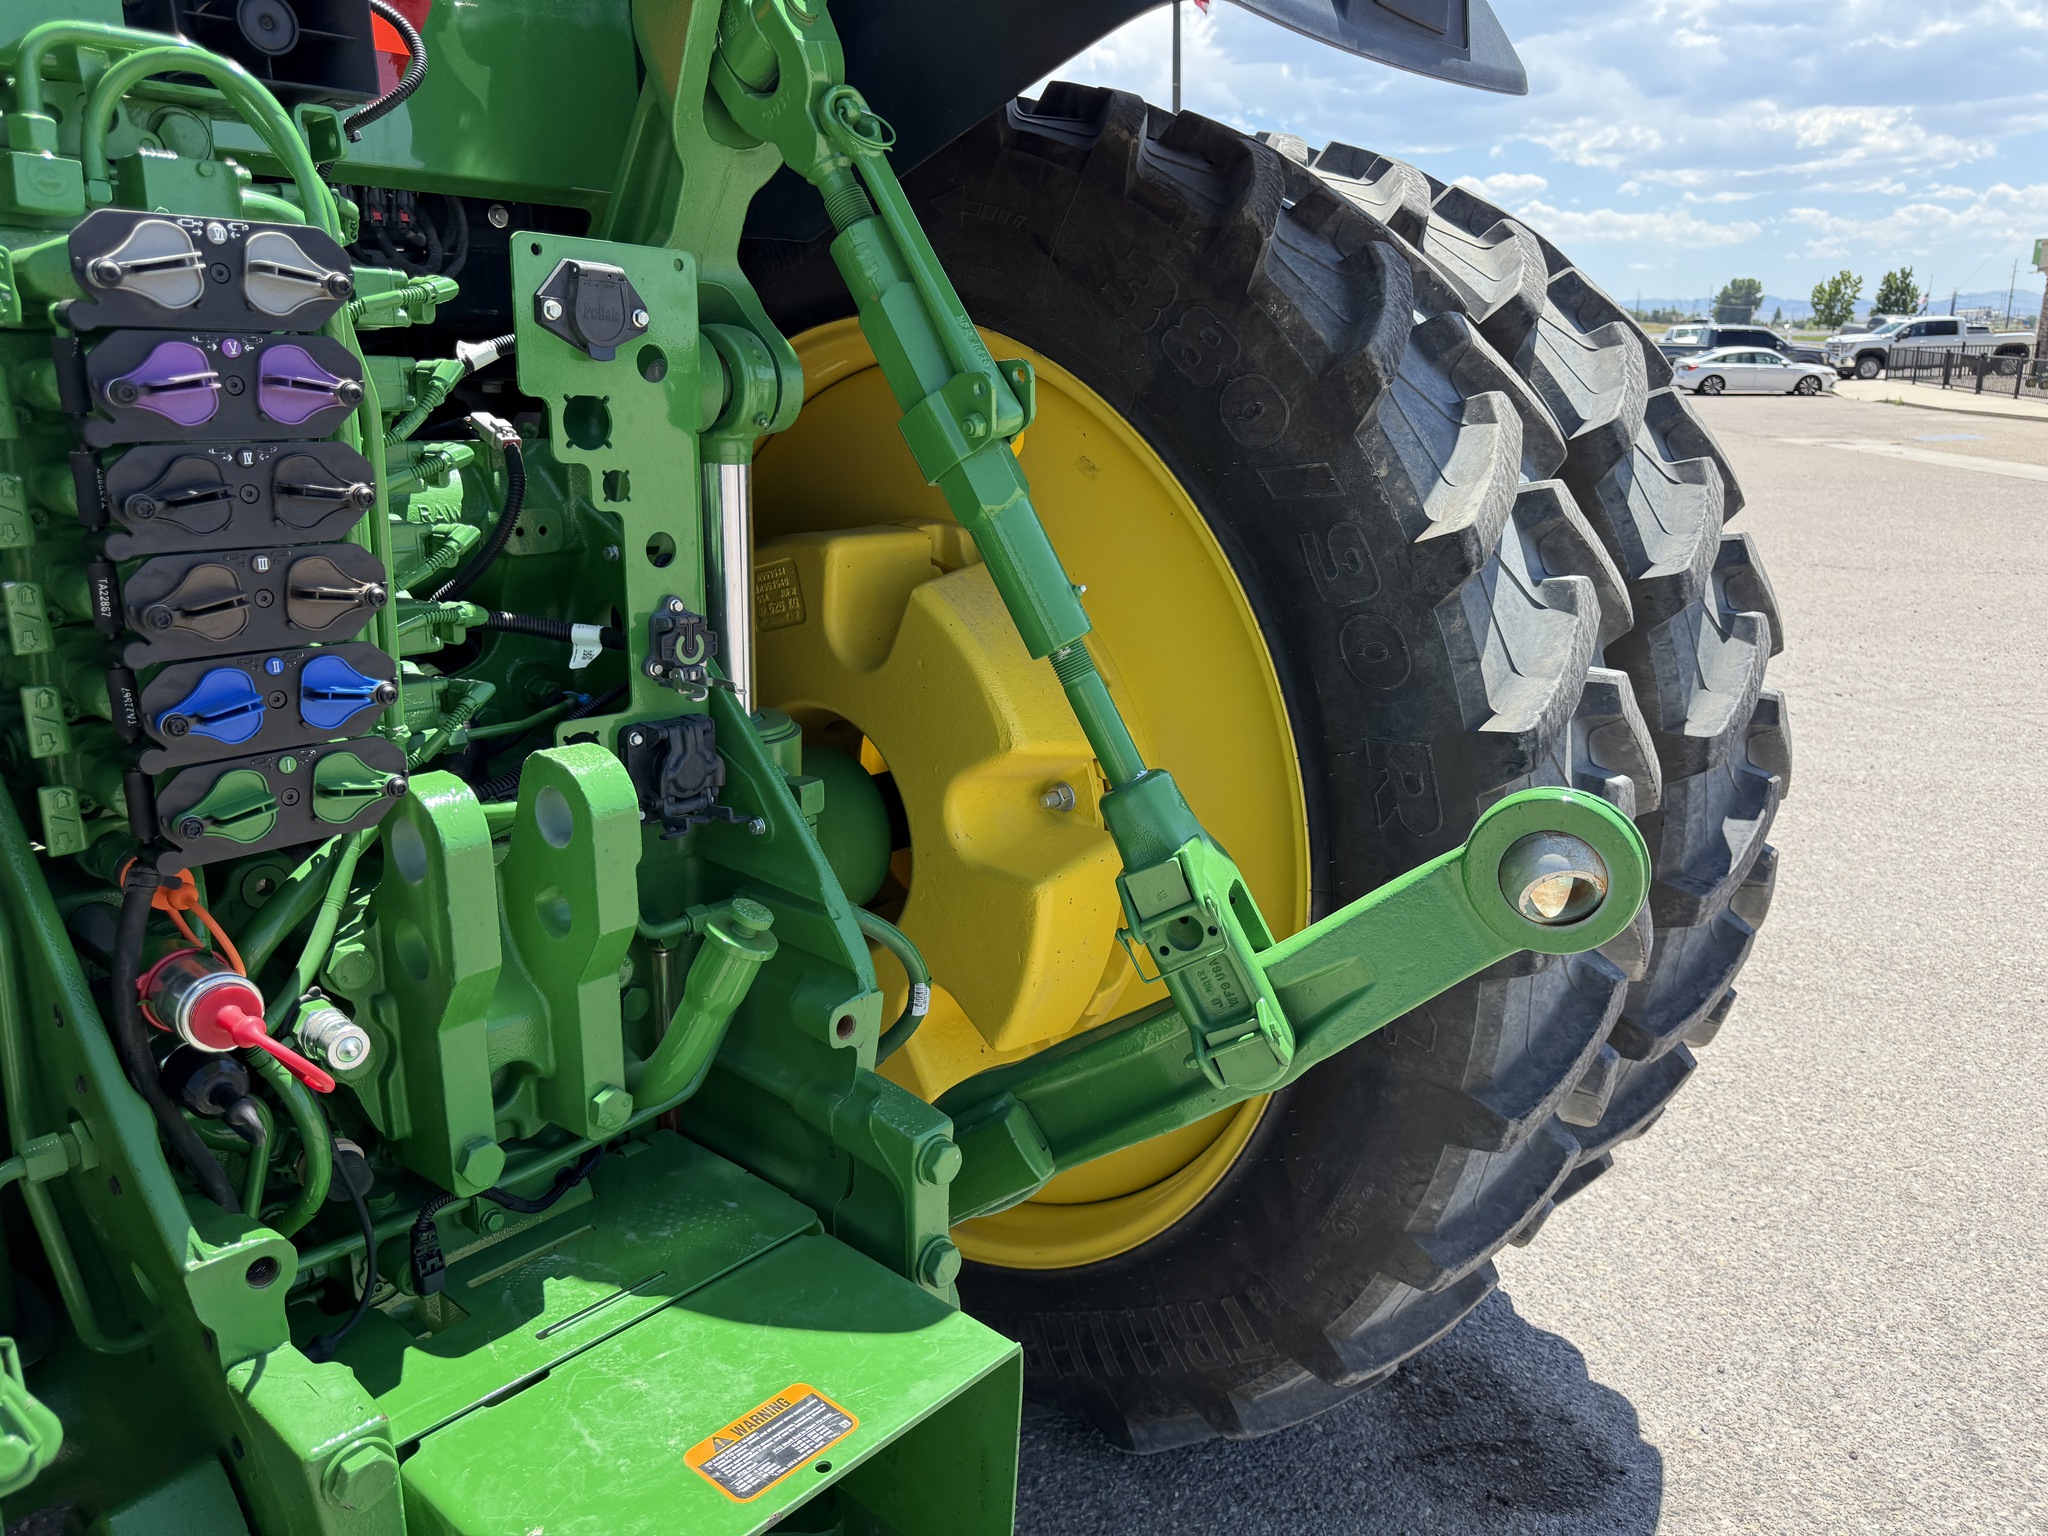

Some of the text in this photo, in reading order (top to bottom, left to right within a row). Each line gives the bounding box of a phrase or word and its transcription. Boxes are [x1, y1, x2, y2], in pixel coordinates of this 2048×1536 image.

[583, 302, 620, 323] Pollak
[227, 342, 238, 355] V
[257, 558, 269, 570] III
[272, 661, 281, 673] II
[730, 1397, 791, 1436] WARNING
